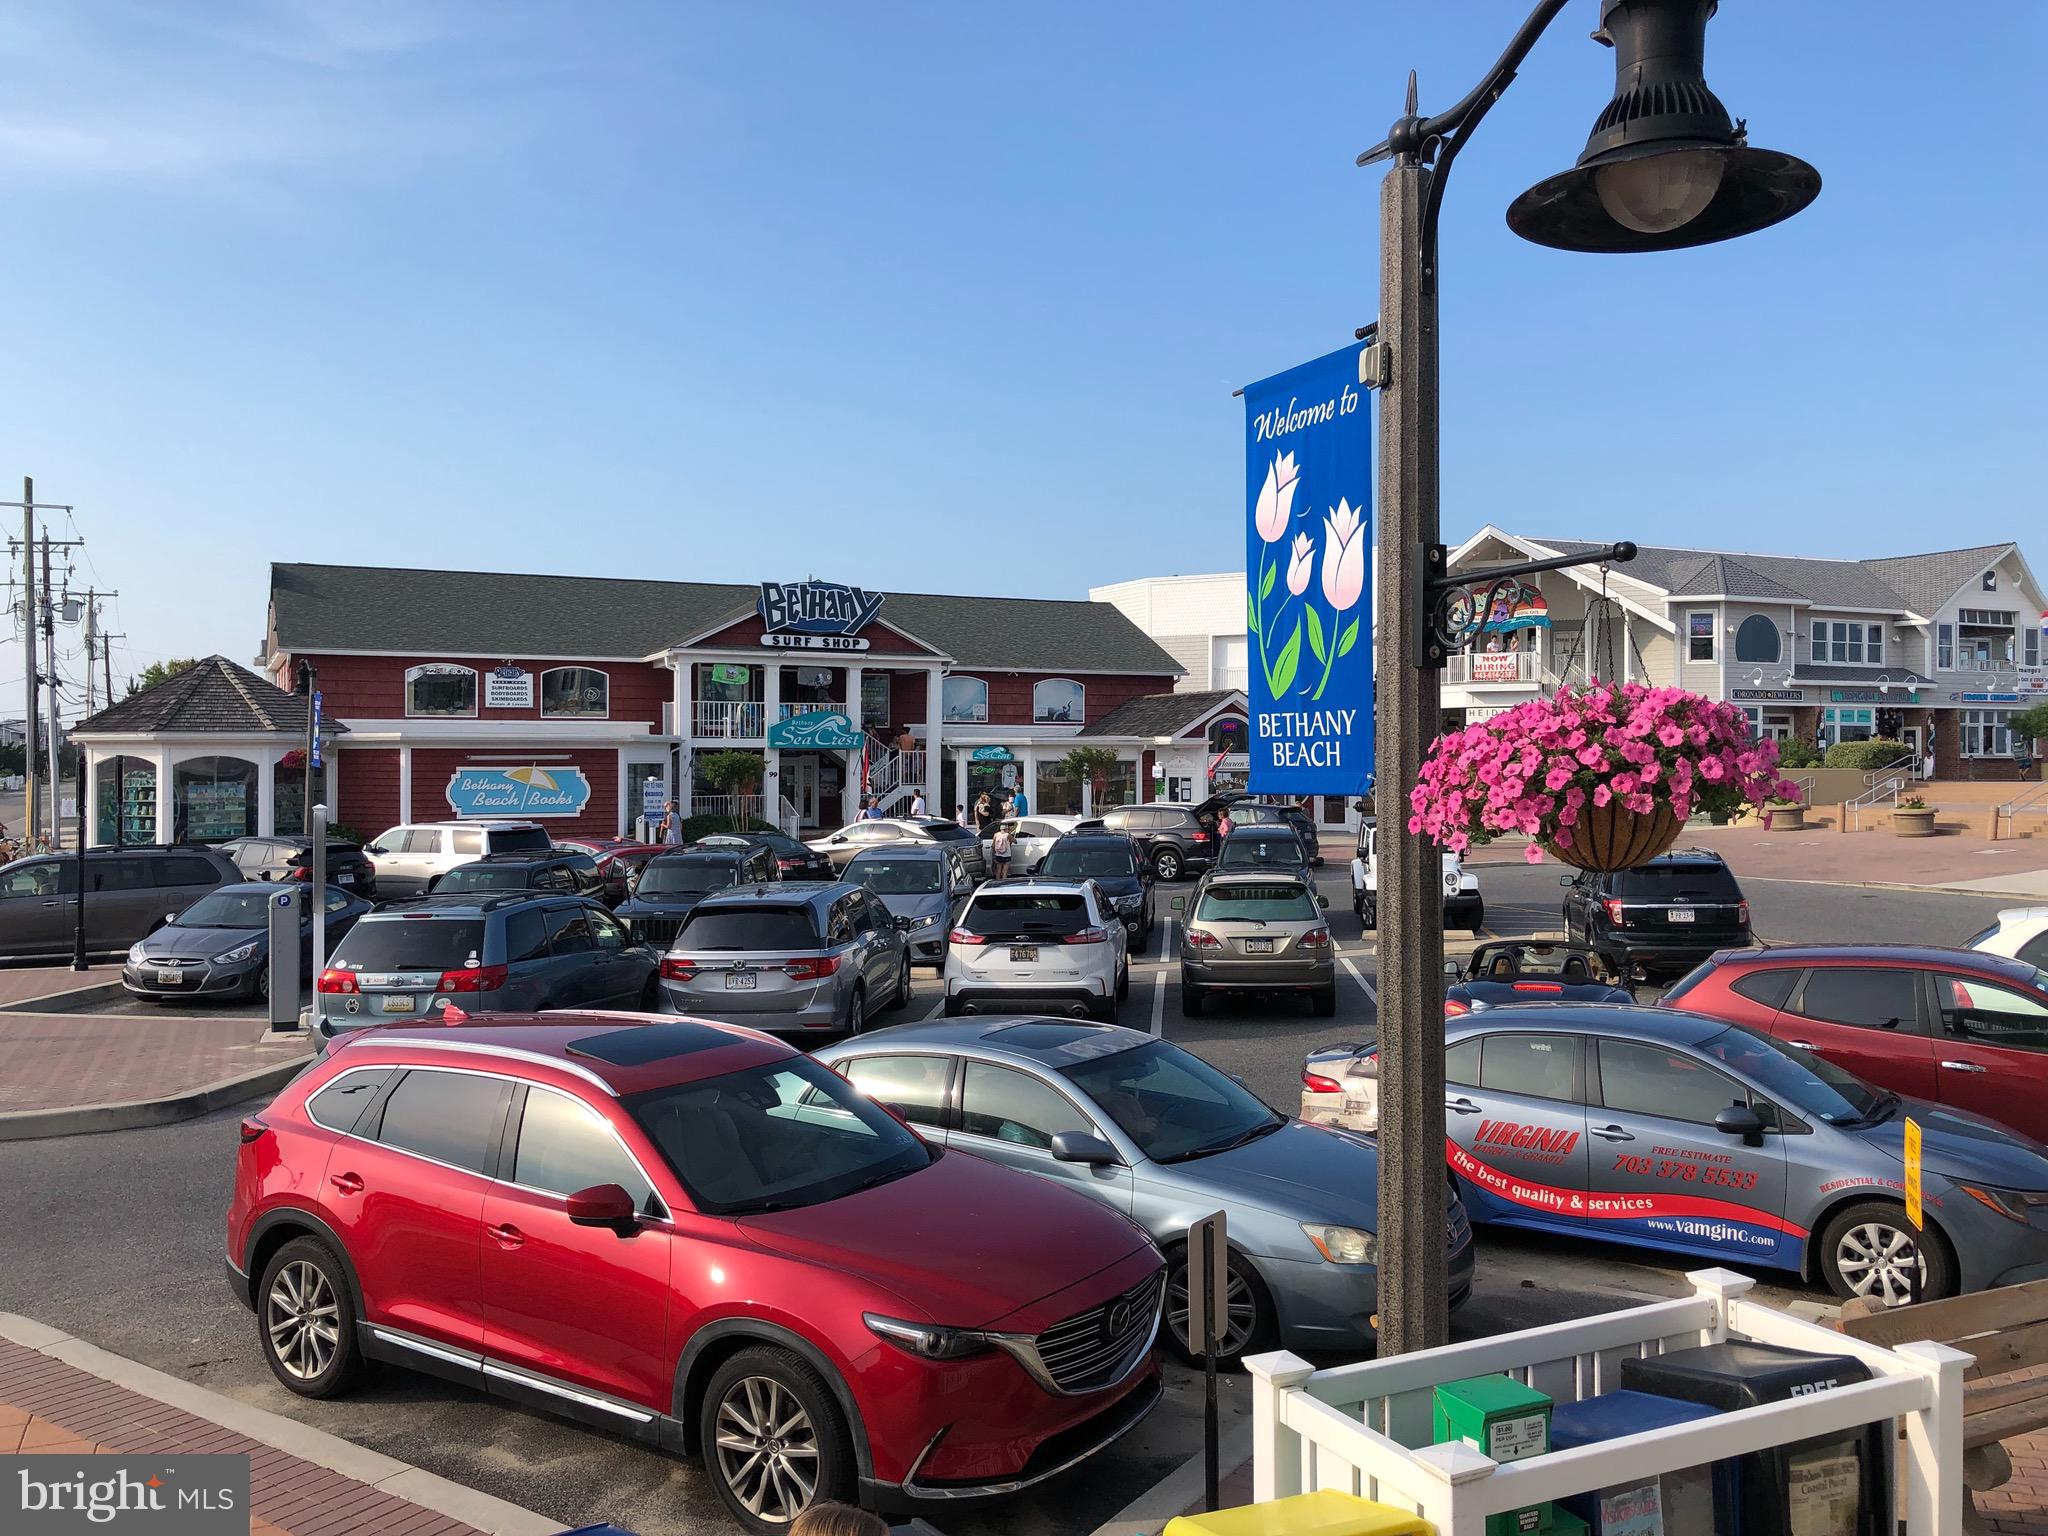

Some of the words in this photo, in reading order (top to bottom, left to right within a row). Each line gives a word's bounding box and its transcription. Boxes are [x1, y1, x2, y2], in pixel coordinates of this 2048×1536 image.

[1254, 397, 1334, 442] Welcome
[1340, 384, 1358, 416] to
[772, 636, 812, 646] SURF
[822, 638, 860, 648] SHOP
[1733, 690, 1767, 698] CORONADO
[1771, 690, 1801, 699] JEWELERS
[1258, 709, 1357, 738] BETHANY
[774, 726, 811, 745] Sea
[815, 727, 859, 746] Crest
[1272, 741, 1341, 767] BEACH
[461, 778, 515, 794] Bethany
[1213, 779, 1225, 787] ICE
[472, 791, 519, 806] Beach
[528, 790, 573, 805] Books
[280, 896, 288, 904] P
[1474, 1120, 1580, 1154] VIRGINIA
[1651, 1146, 1677, 1157] FREE
[1680, 1150, 1732, 1164] ESTIMATE
[1453, 1150, 1475, 1172] the
[1477, 1166, 1507, 1190] best
[1512, 1185, 1565, 1209] quality
[1570, 1195, 1583, 1209] &
[1588, 1197, 1653, 1210] services
[1612, 1153, 1654, 1175] 703
[1656, 1160, 1698, 1183] 378
[1702, 1166, 1759, 1190] 5533
[1819, 1177, 1875, 1193] RESIDENTIAL
[1877, 1177, 1883, 1186] &
[1801, 1479, 1827, 1494] Coastal
